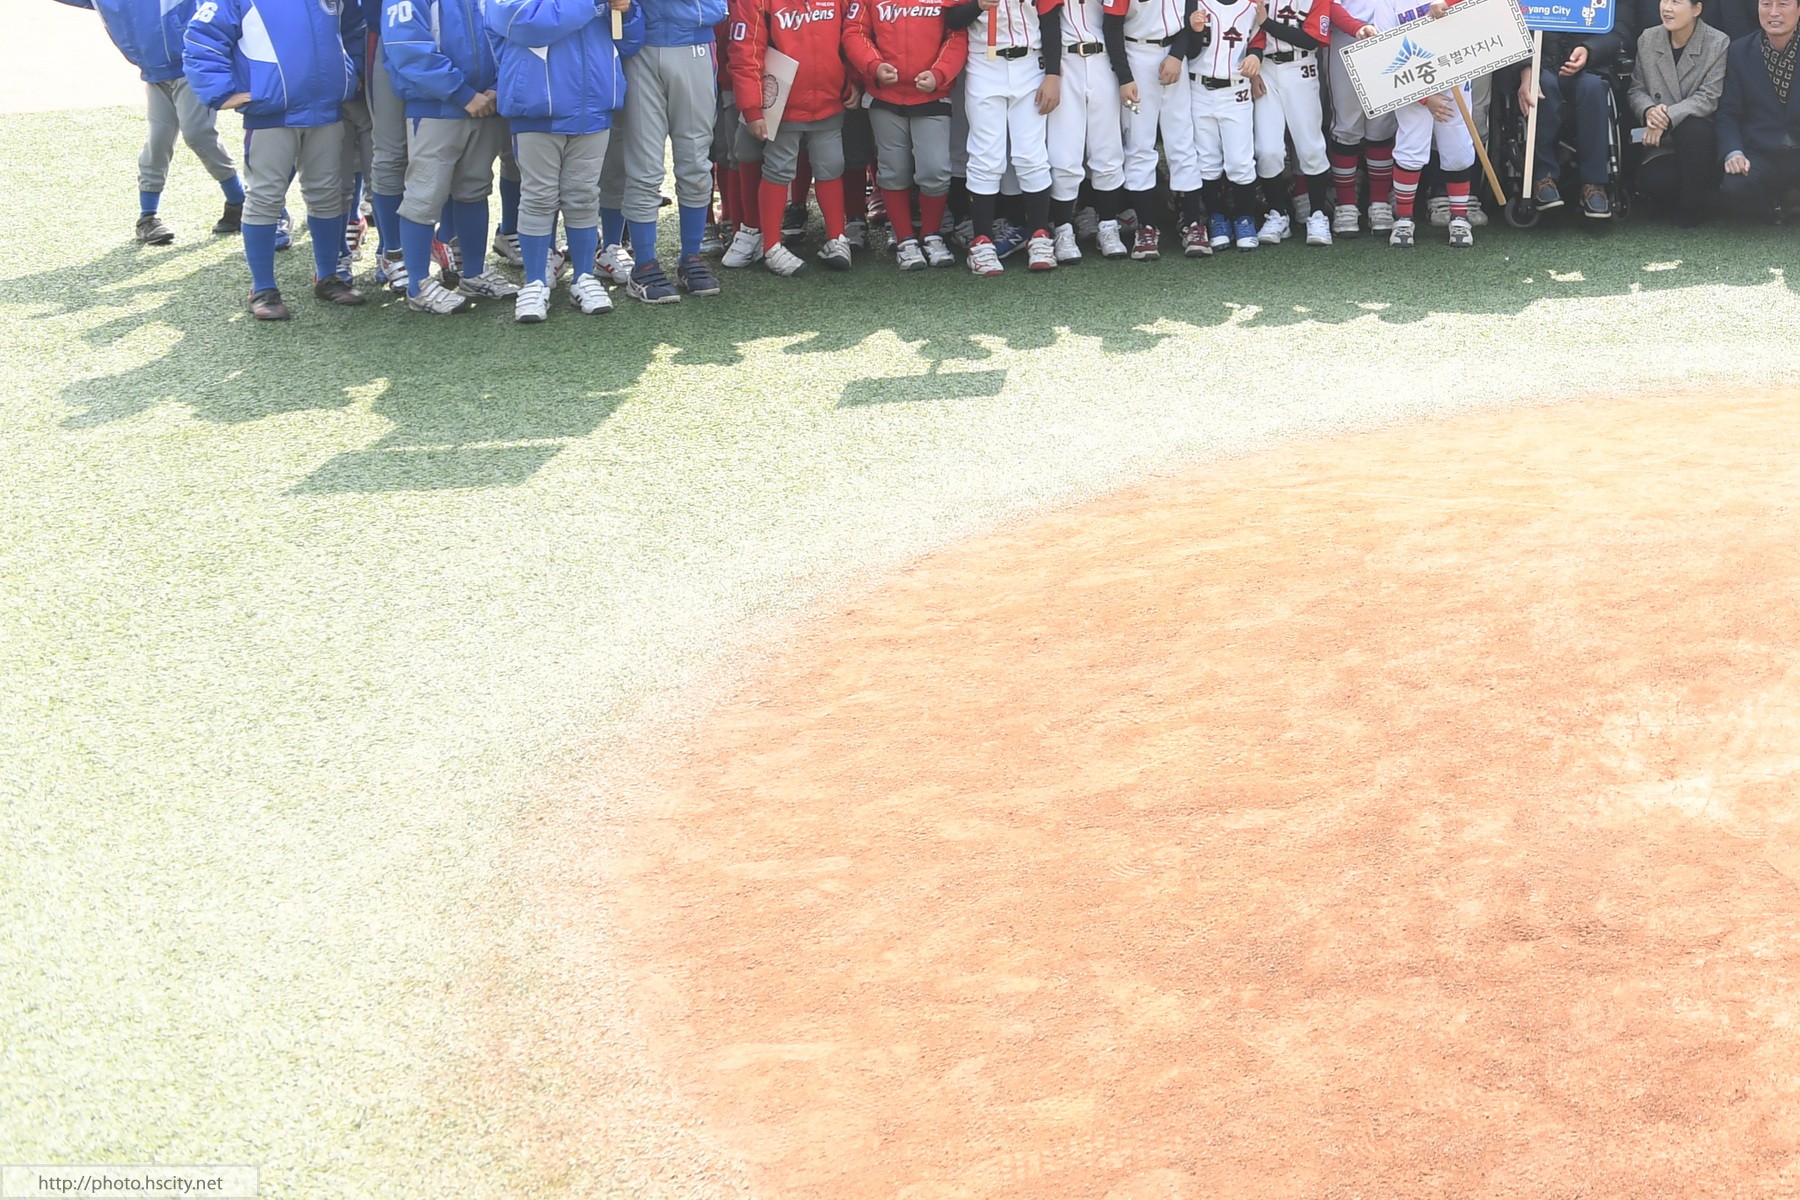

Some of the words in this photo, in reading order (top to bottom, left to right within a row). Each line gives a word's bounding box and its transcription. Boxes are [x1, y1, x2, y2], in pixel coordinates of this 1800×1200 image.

[387, 0, 412, 27] 70
[875, 0, 942, 23] Wyverns
[1552, 5, 1572, 17] City
[689, 44, 705, 58] 16
[1393, 61, 1437, 88] 세종
[1437, 34, 1504, 68] 특별자치시
[1300, 64, 1316, 78] 35
[1235, 89, 1249, 102] 32
